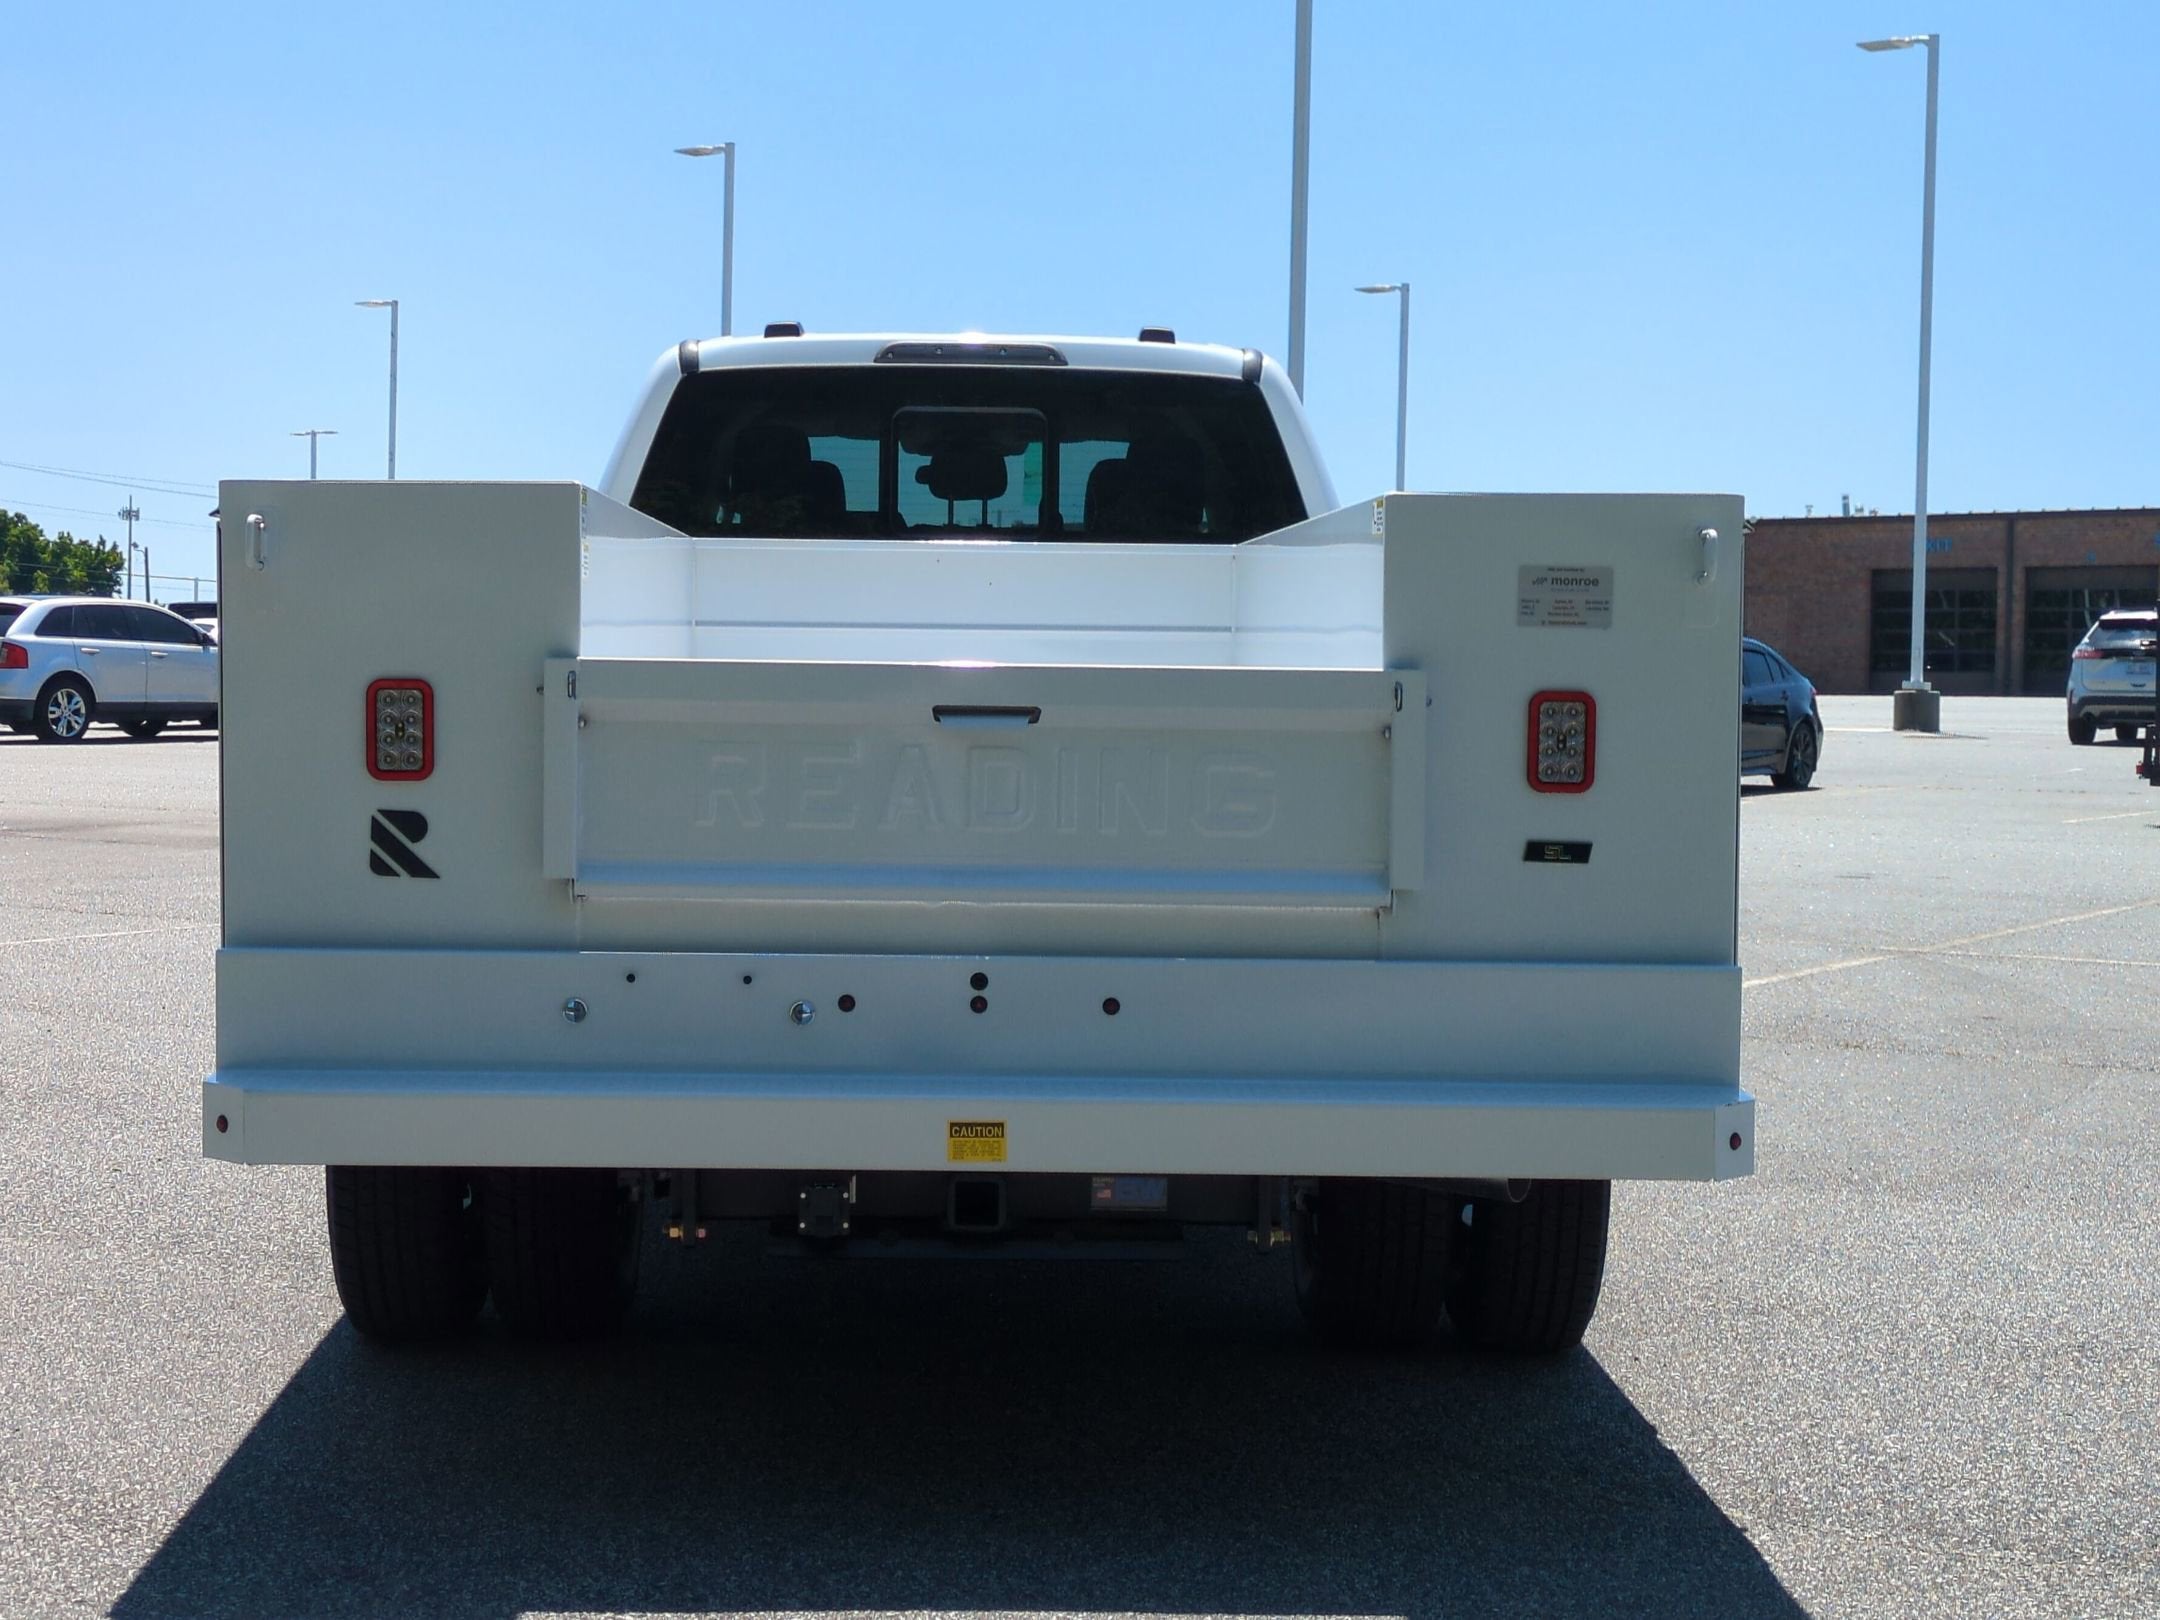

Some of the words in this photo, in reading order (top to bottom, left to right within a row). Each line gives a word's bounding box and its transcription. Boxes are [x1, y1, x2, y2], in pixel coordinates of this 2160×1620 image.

[1551, 577, 1599, 586] monroe
[695, 740, 1278, 839] READING
[951, 1126, 1002, 1137] CAUTION
